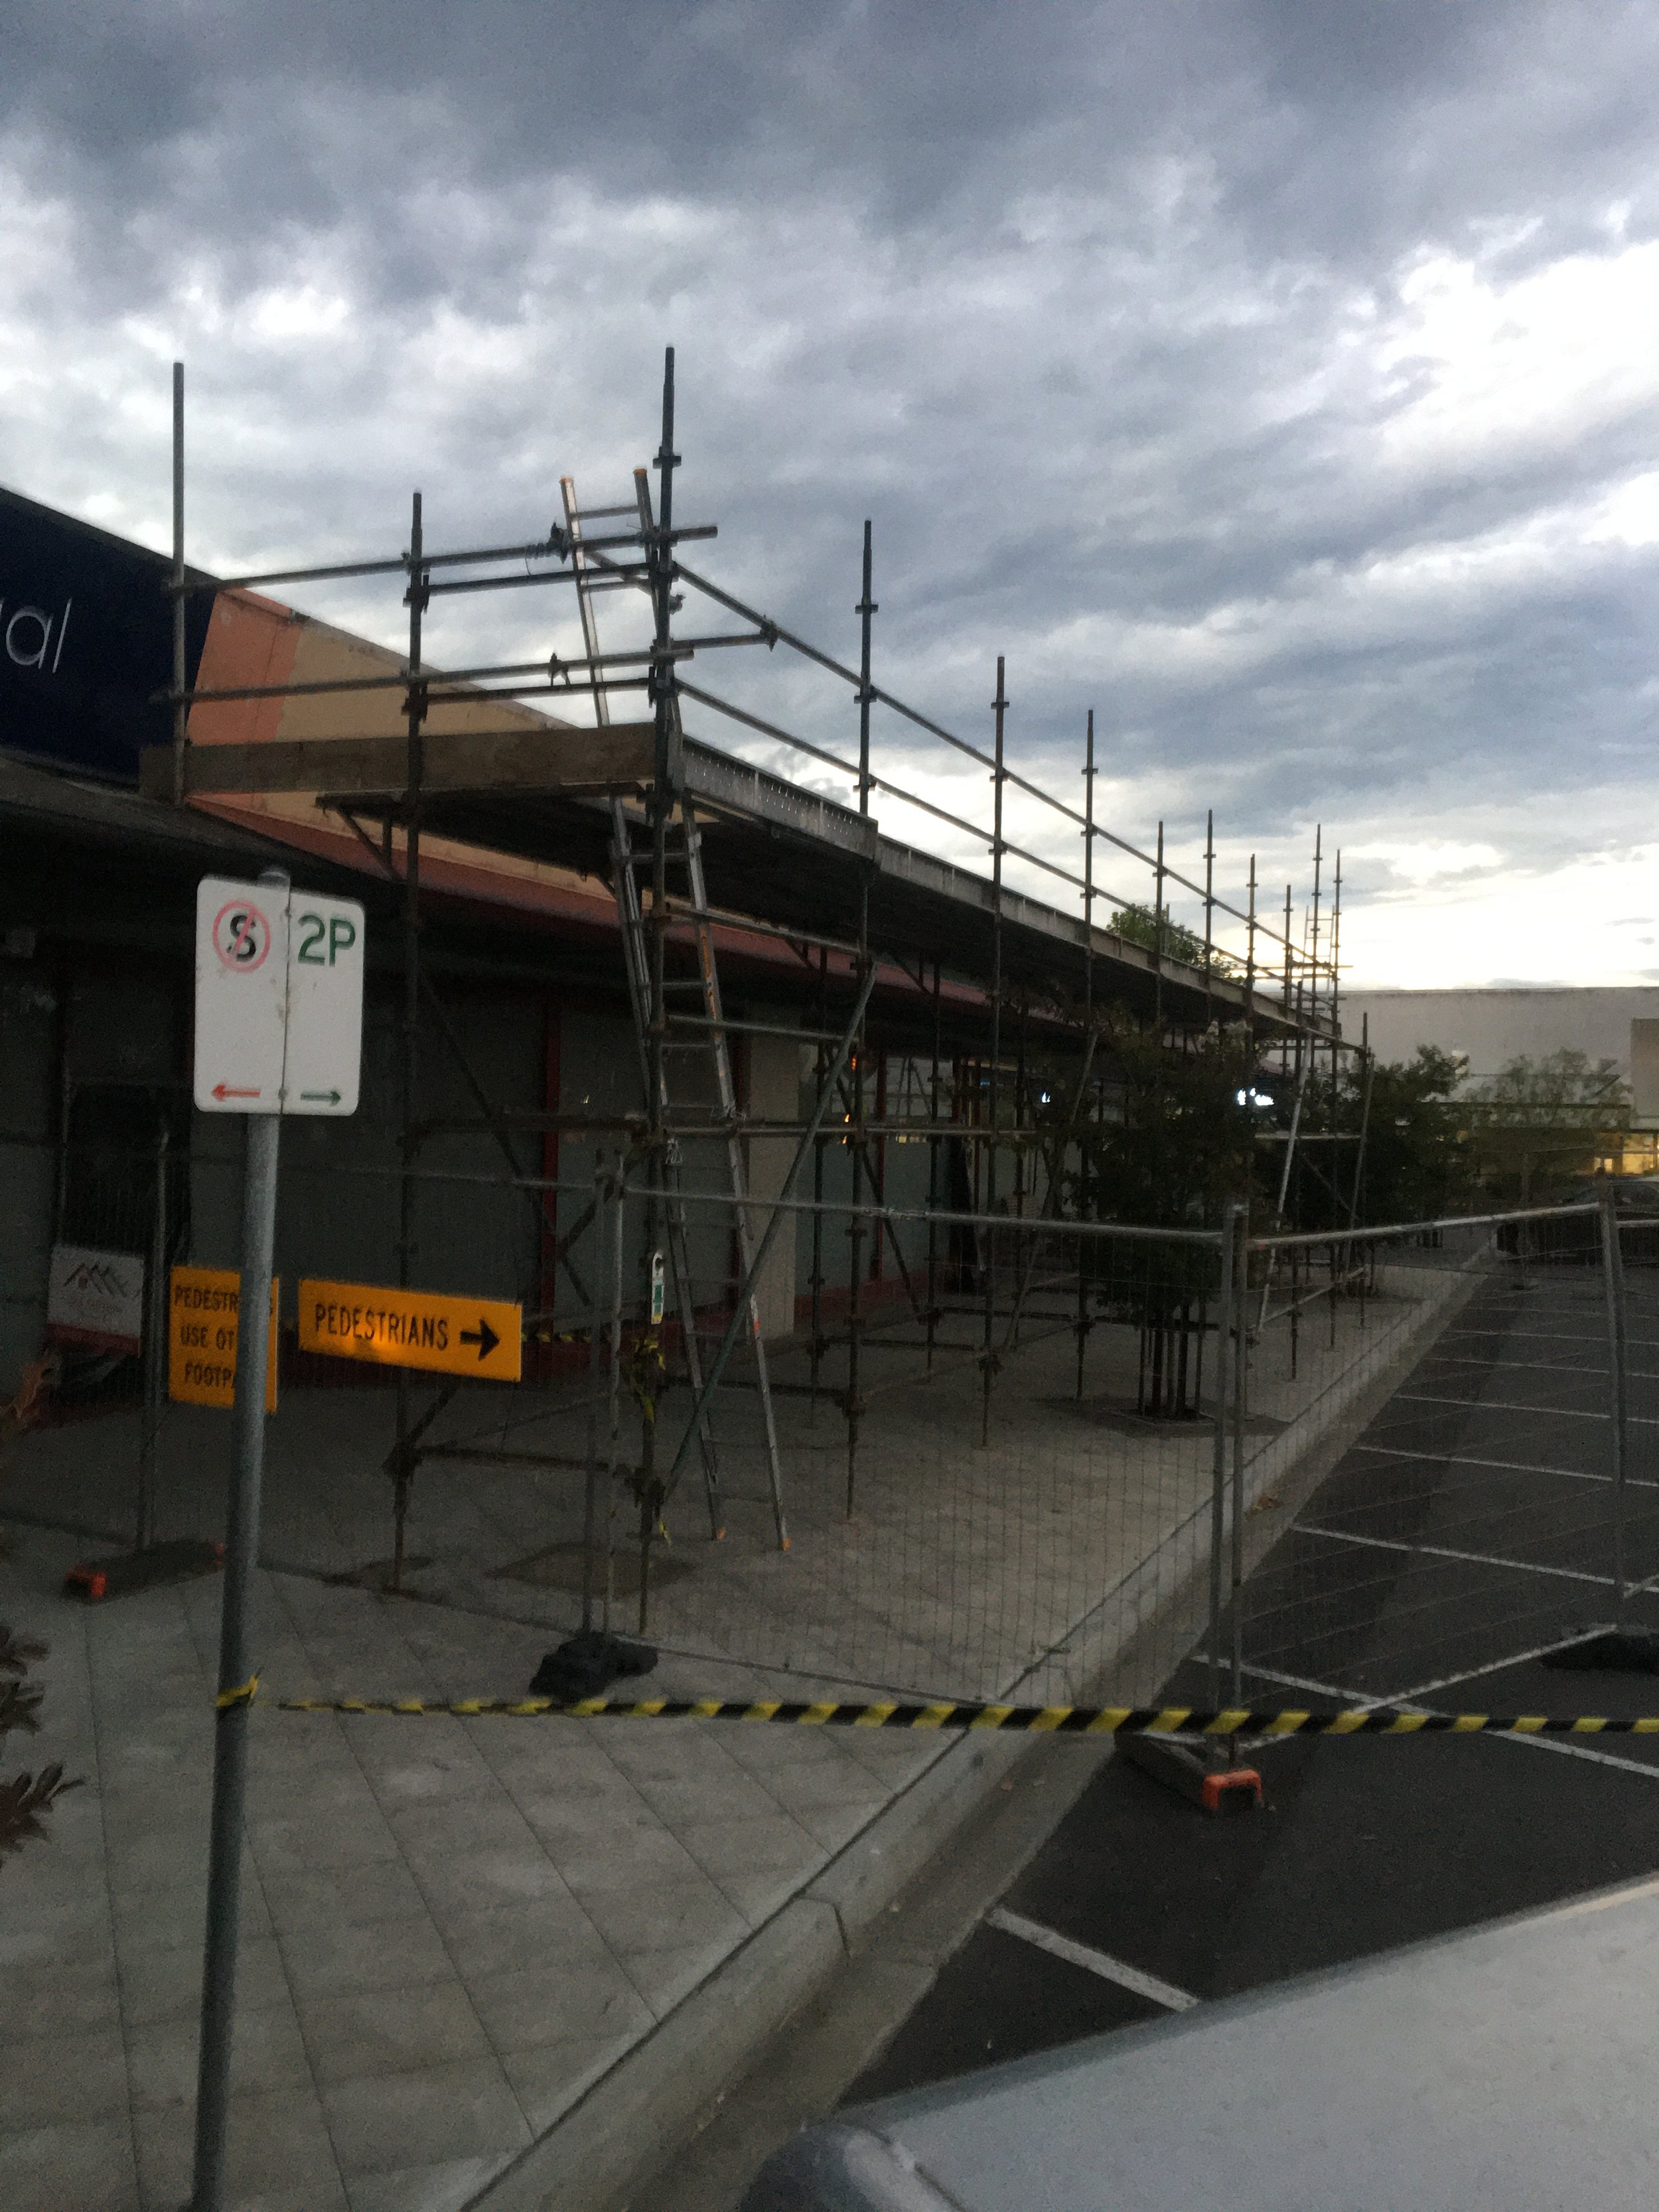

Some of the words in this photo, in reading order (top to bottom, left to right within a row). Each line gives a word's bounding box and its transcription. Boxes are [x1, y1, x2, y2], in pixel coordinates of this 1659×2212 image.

[0, 598, 72, 673] al
[298, 912, 356, 967] 2P
[175, 1285, 240, 1313] PEDESTR
[180, 1324, 208, 1348] USE
[315, 1303, 449, 1351] PEDESTRIANS
[185, 1361, 234, 1388] FOOTP
